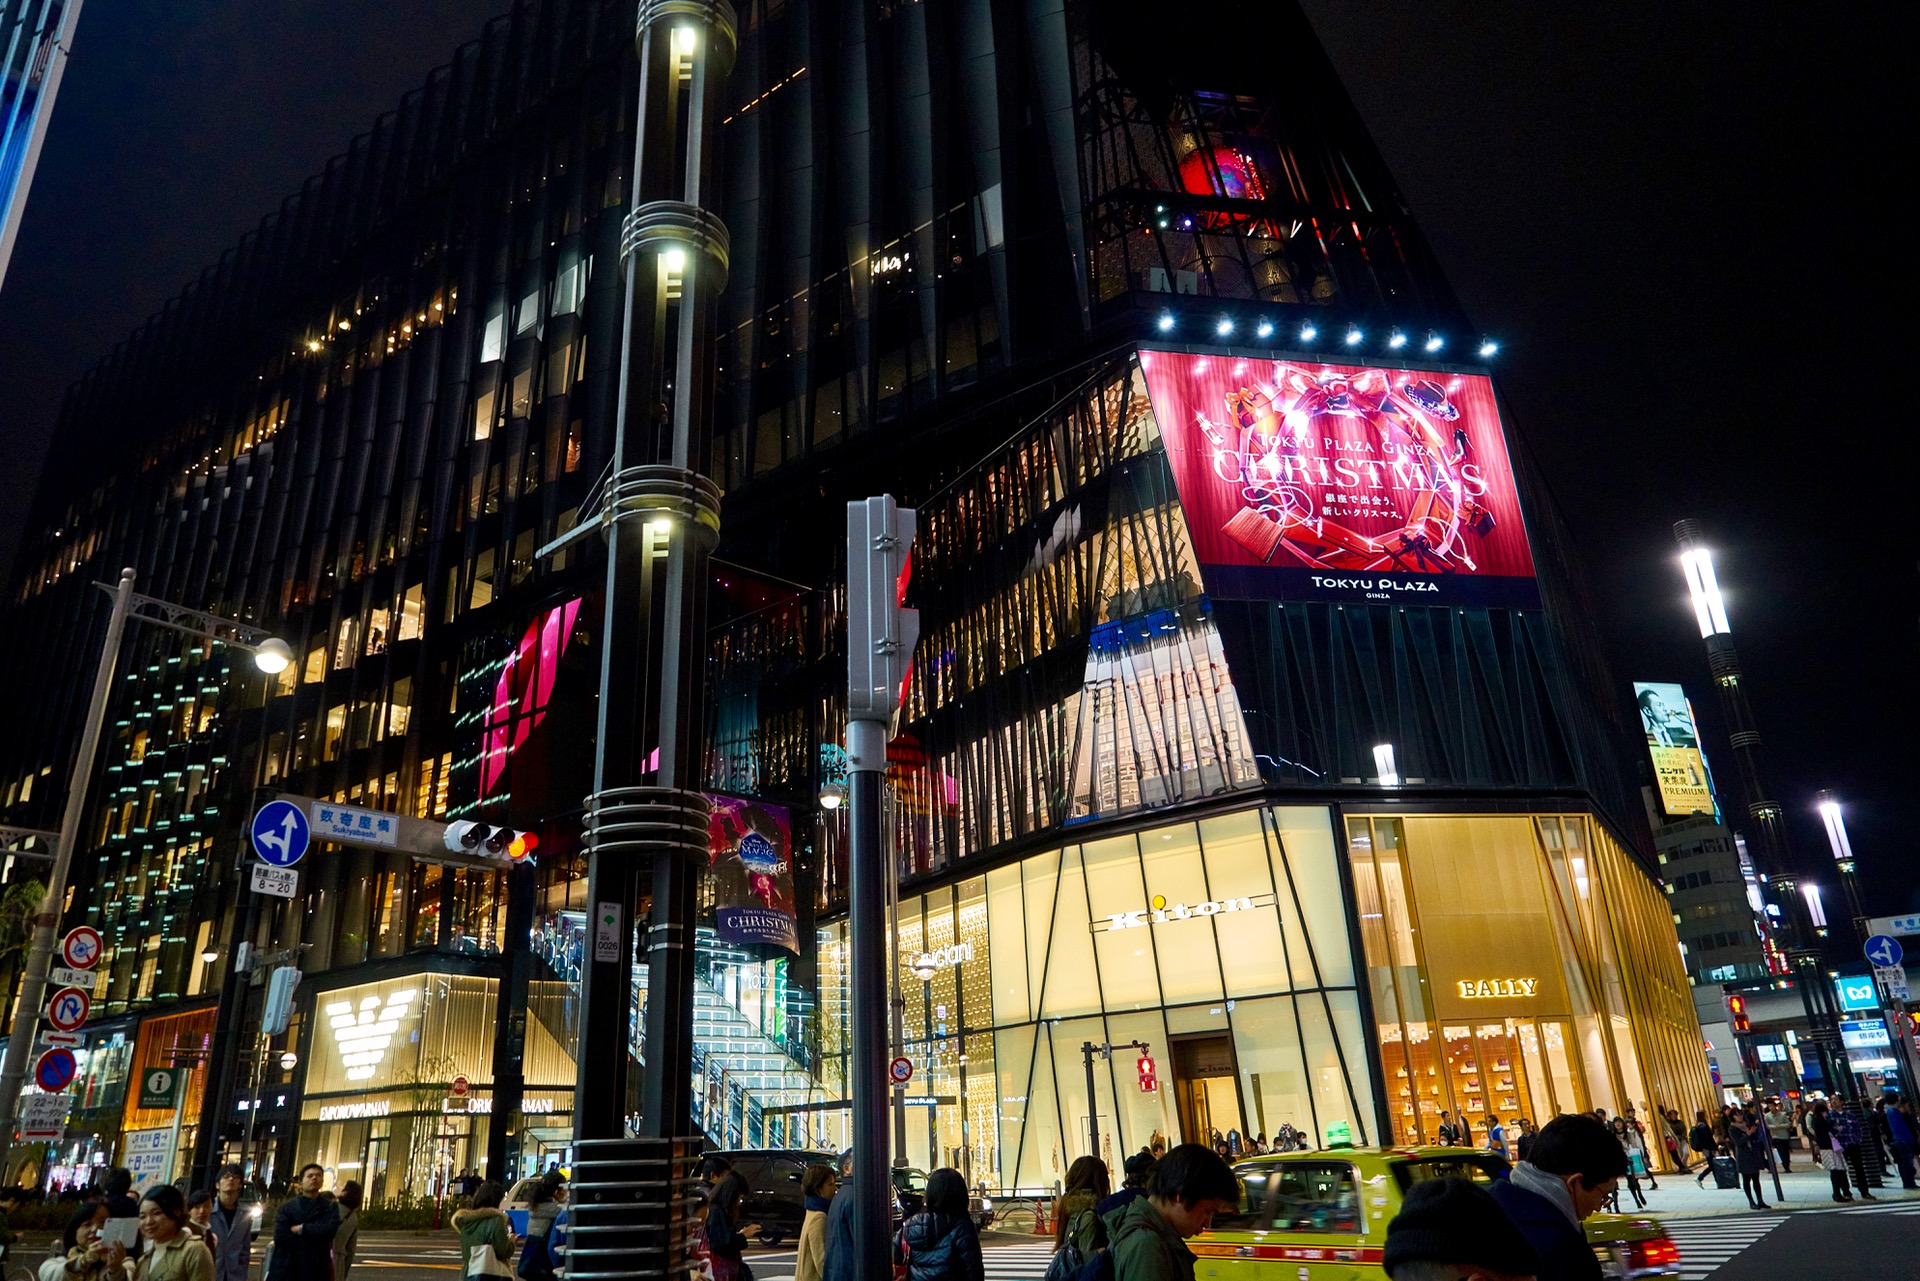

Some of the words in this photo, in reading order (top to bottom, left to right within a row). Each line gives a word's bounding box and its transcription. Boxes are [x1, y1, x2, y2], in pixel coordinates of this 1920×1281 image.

[1257, 433, 1315, 449] TOKYU
[1325, 439, 1374, 453] PLAZA
[1381, 441, 1436, 456] GINZA
[1213, 450, 1487, 497] CHRISTMAS
[1325, 493, 1395, 506] 銀座で出会う、
[1322, 506, 1403, 519] 新しいクリスマス。
[1311, 576, 1373, 590] TOKYU
[1378, 579, 1439, 592] PLAZA
[1660, 767, 1685, 775] ユンケル
[1664, 788, 1706, 796] PREMIUM
[320, 809, 391, 832] 数寄屋橋
[332, 824, 377, 839] Sukiyabashi
[1107, 895, 1256, 931] Kiton
[598, 942, 618, 950] 0026
[1459, 978, 1537, 997] BALLY
